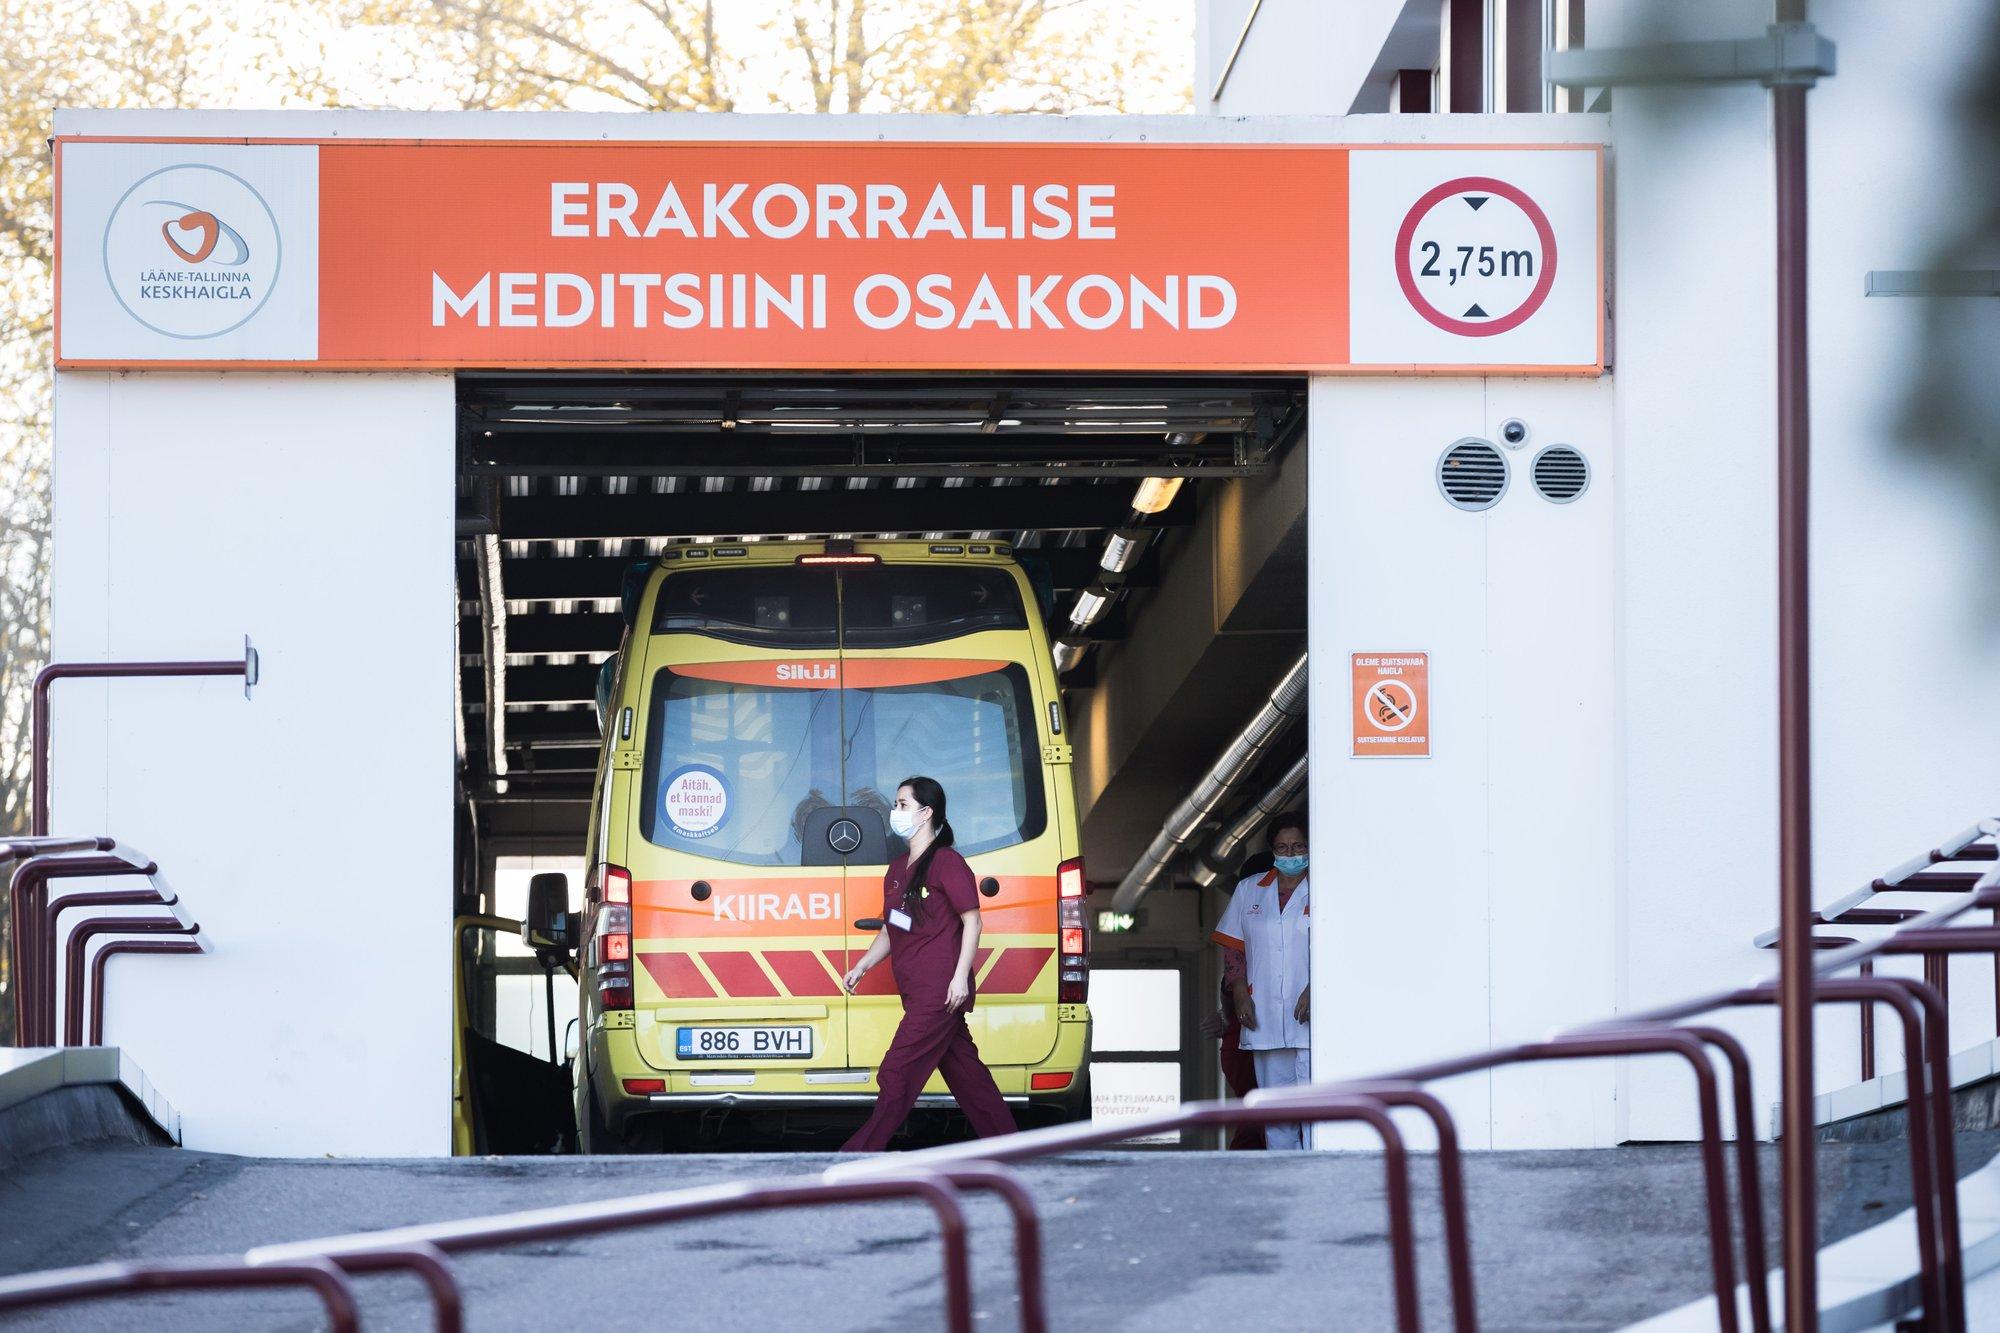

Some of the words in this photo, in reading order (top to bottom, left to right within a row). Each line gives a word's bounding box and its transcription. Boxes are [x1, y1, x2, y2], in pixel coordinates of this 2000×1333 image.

[550, 181, 1117, 240] ERAKORRALISE
[1420, 240, 1534, 286] 2,75m
[140, 268, 251, 283] LÄÄNE-TALLINNA
[140, 284, 252, 300] KESKHAIGLA
[432, 270, 826, 330] MEDITSIINI
[853, 272, 1238, 331] OSAKOND
[1356, 658, 1380, 666] OLEME
[1381, 658, 1424, 666] SUITSUVABA
[1377, 667, 1403, 675] HAIGLA
[681, 778, 712, 791] Aitäh,
[670, 793, 682, 804] et
[684, 791, 722, 804] kannad
[678, 805, 713, 817] maski!
[713, 892, 841, 921] KIIRABI
[700, 1030, 740, 1051] 886
[753, 1030, 802, 1051] BVH
